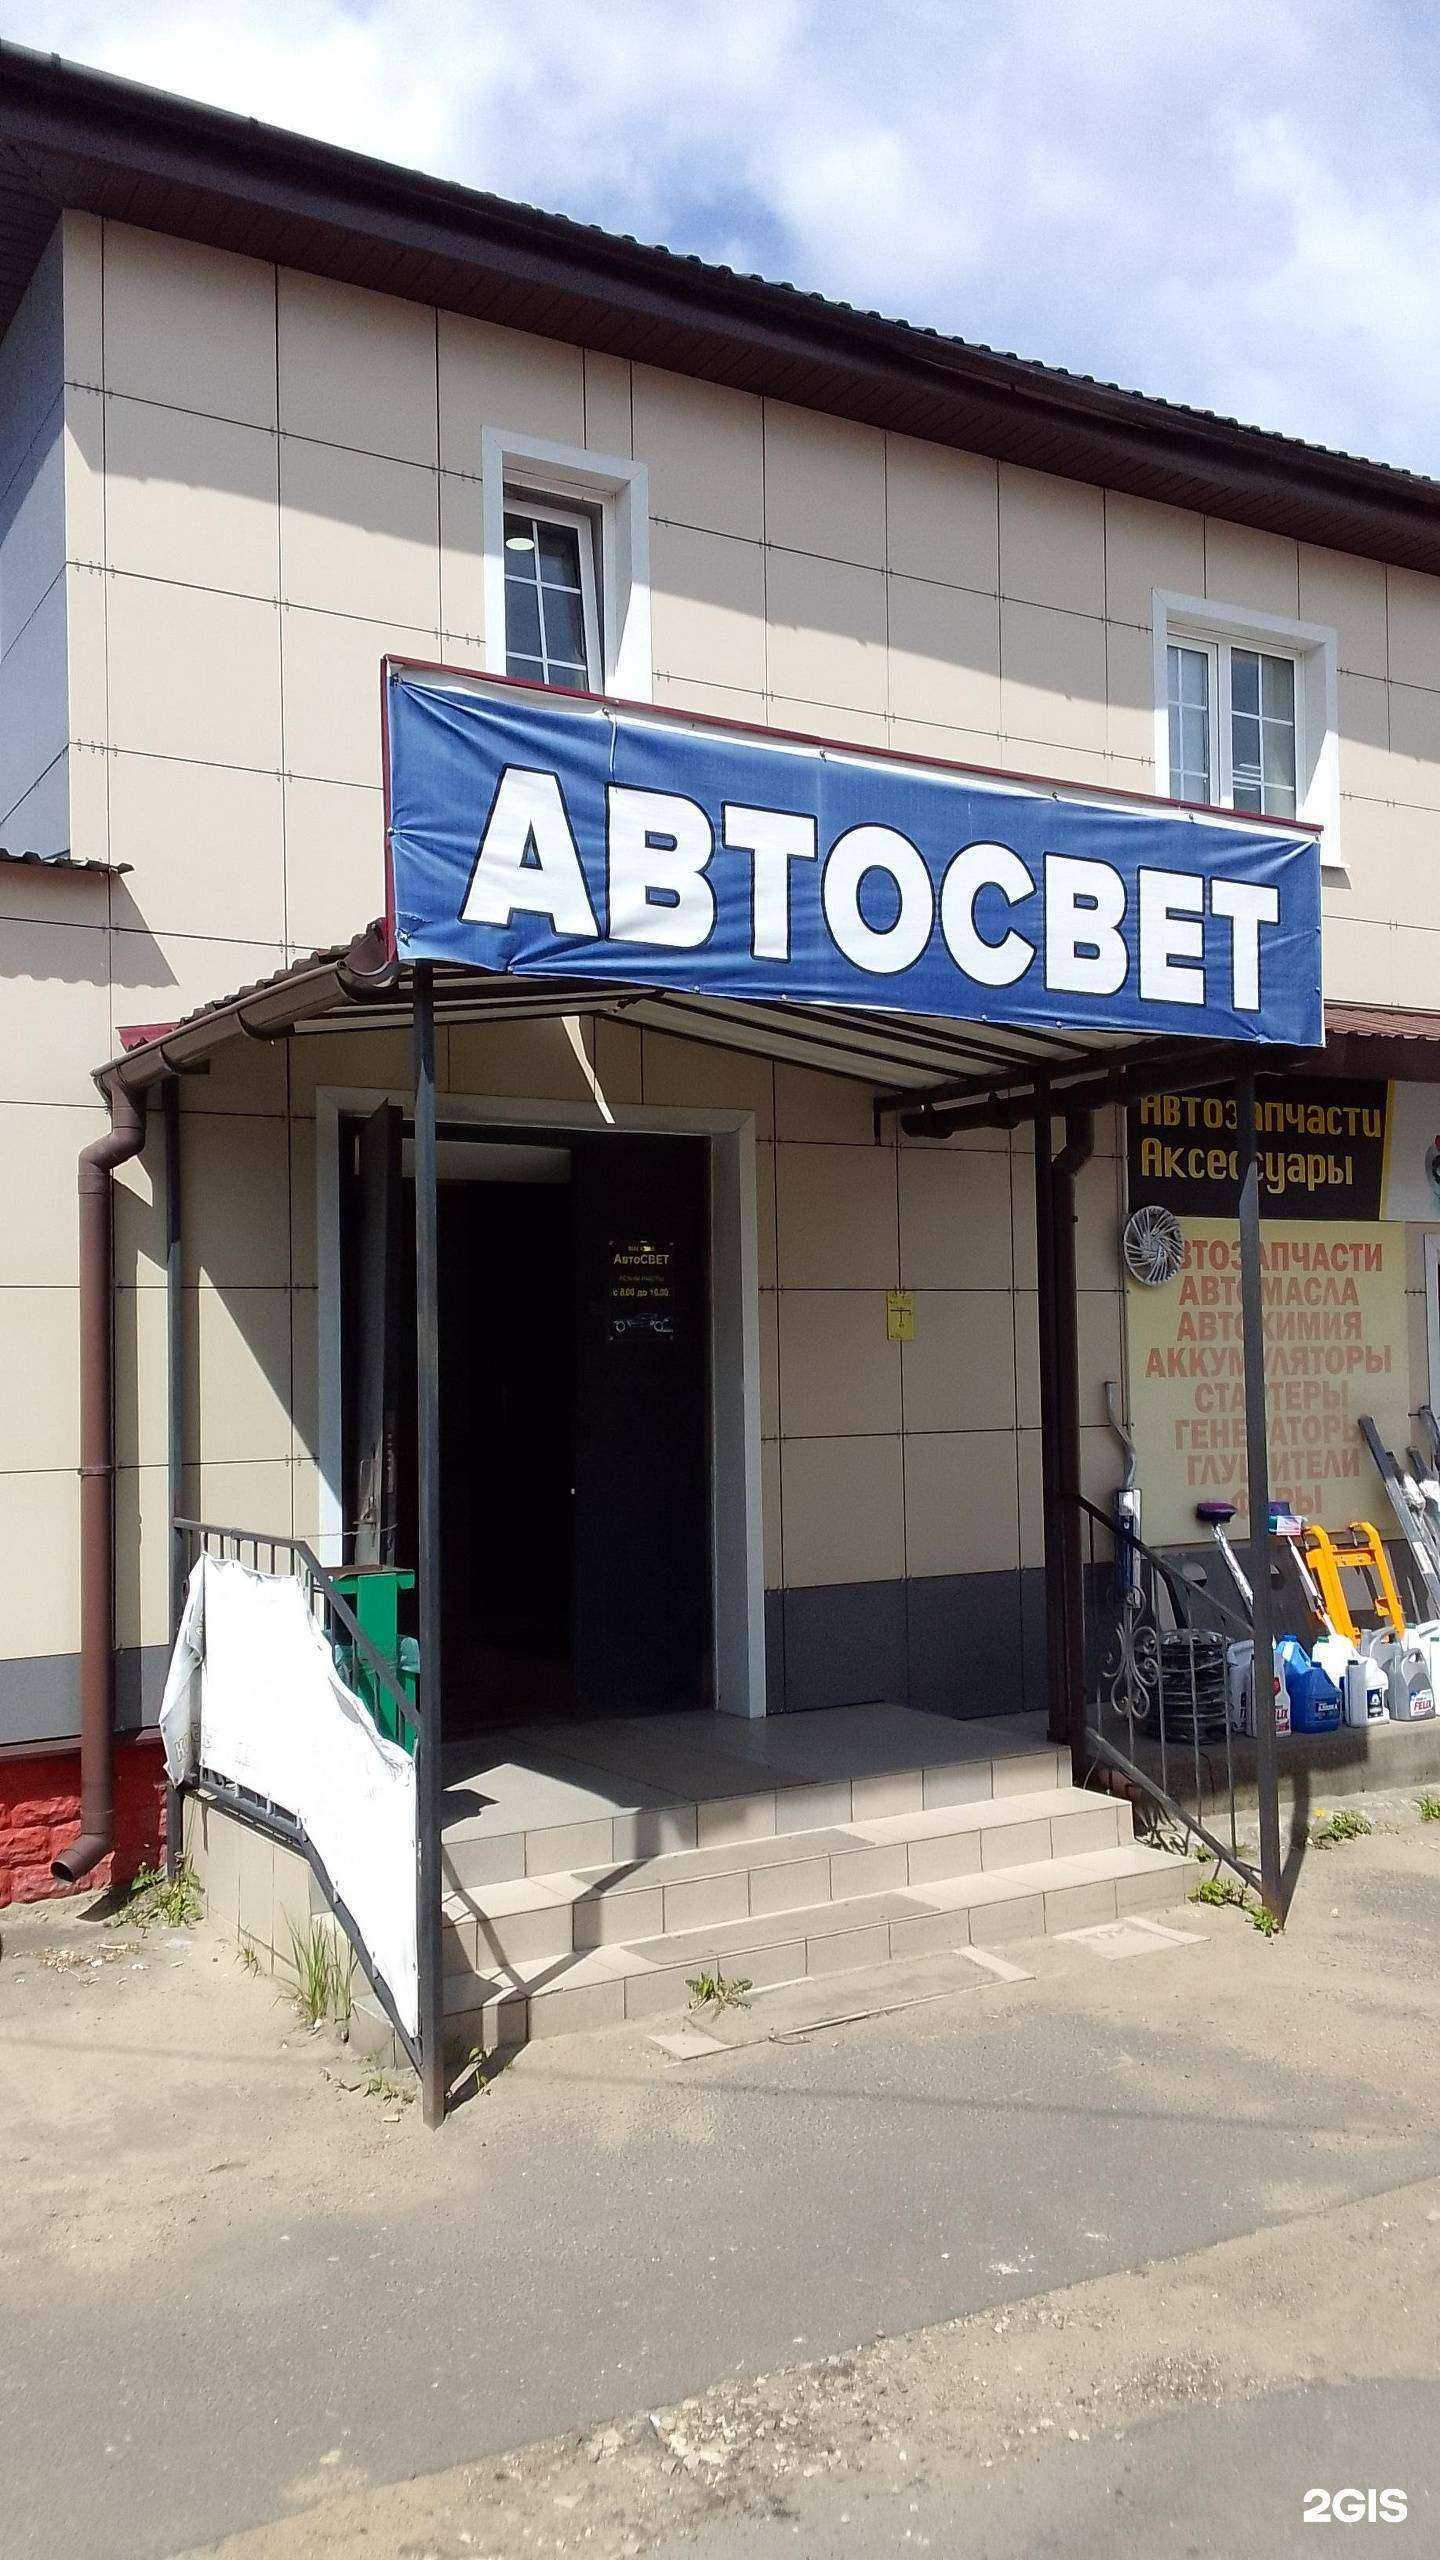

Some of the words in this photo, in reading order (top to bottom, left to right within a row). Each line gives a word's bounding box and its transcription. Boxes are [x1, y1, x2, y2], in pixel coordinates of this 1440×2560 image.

[458, 762, 1279, 1012] АВТОСВЕТ
[1181, 1239, 1383, 1272] ВТОЗАПЧАСТИ
[1194, 1380, 1349, 1414] СТАТЕРЫ
[1173, 1413, 1366, 1451] ГЕНЕАТОРЫ
[1187, 1447, 1361, 1486] ГЛУИТЕЛИ
